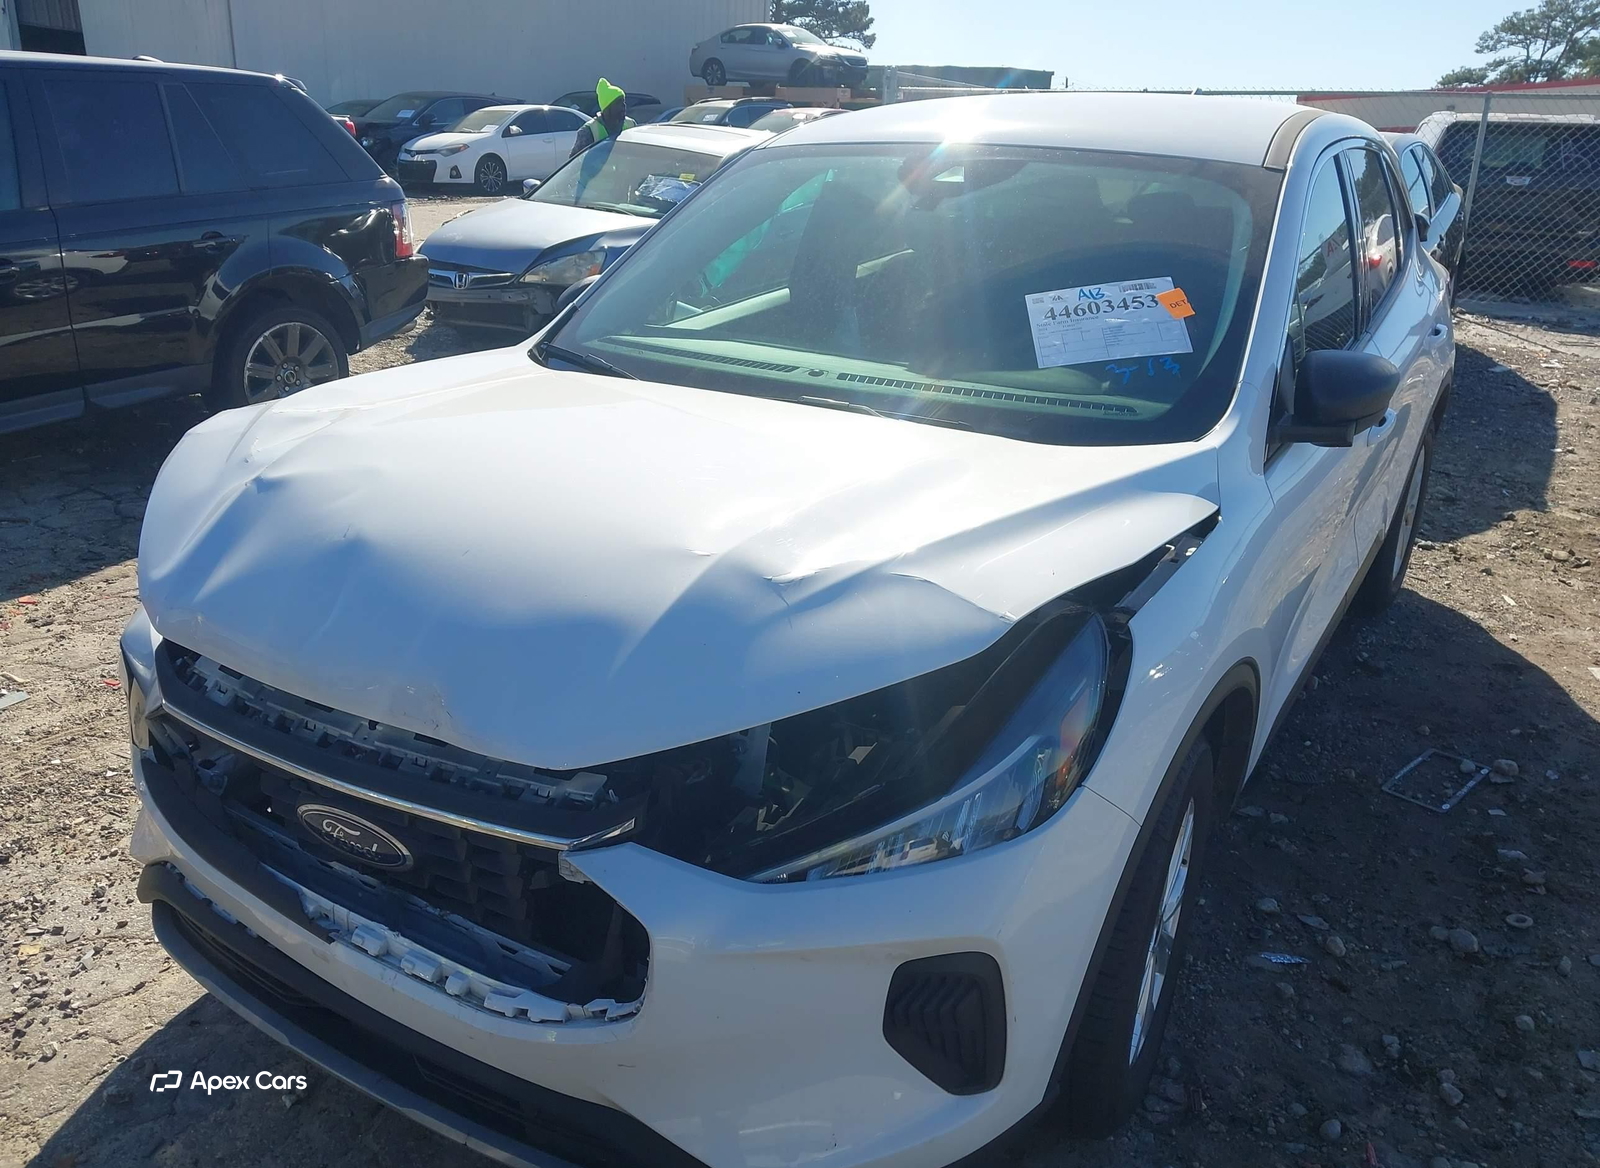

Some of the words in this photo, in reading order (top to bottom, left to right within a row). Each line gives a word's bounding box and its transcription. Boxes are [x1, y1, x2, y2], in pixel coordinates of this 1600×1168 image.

[1043, 294, 1159, 321] 44603453
[1169, 298, 1188, 309] DET
[322, 819, 381, 861] Ford
